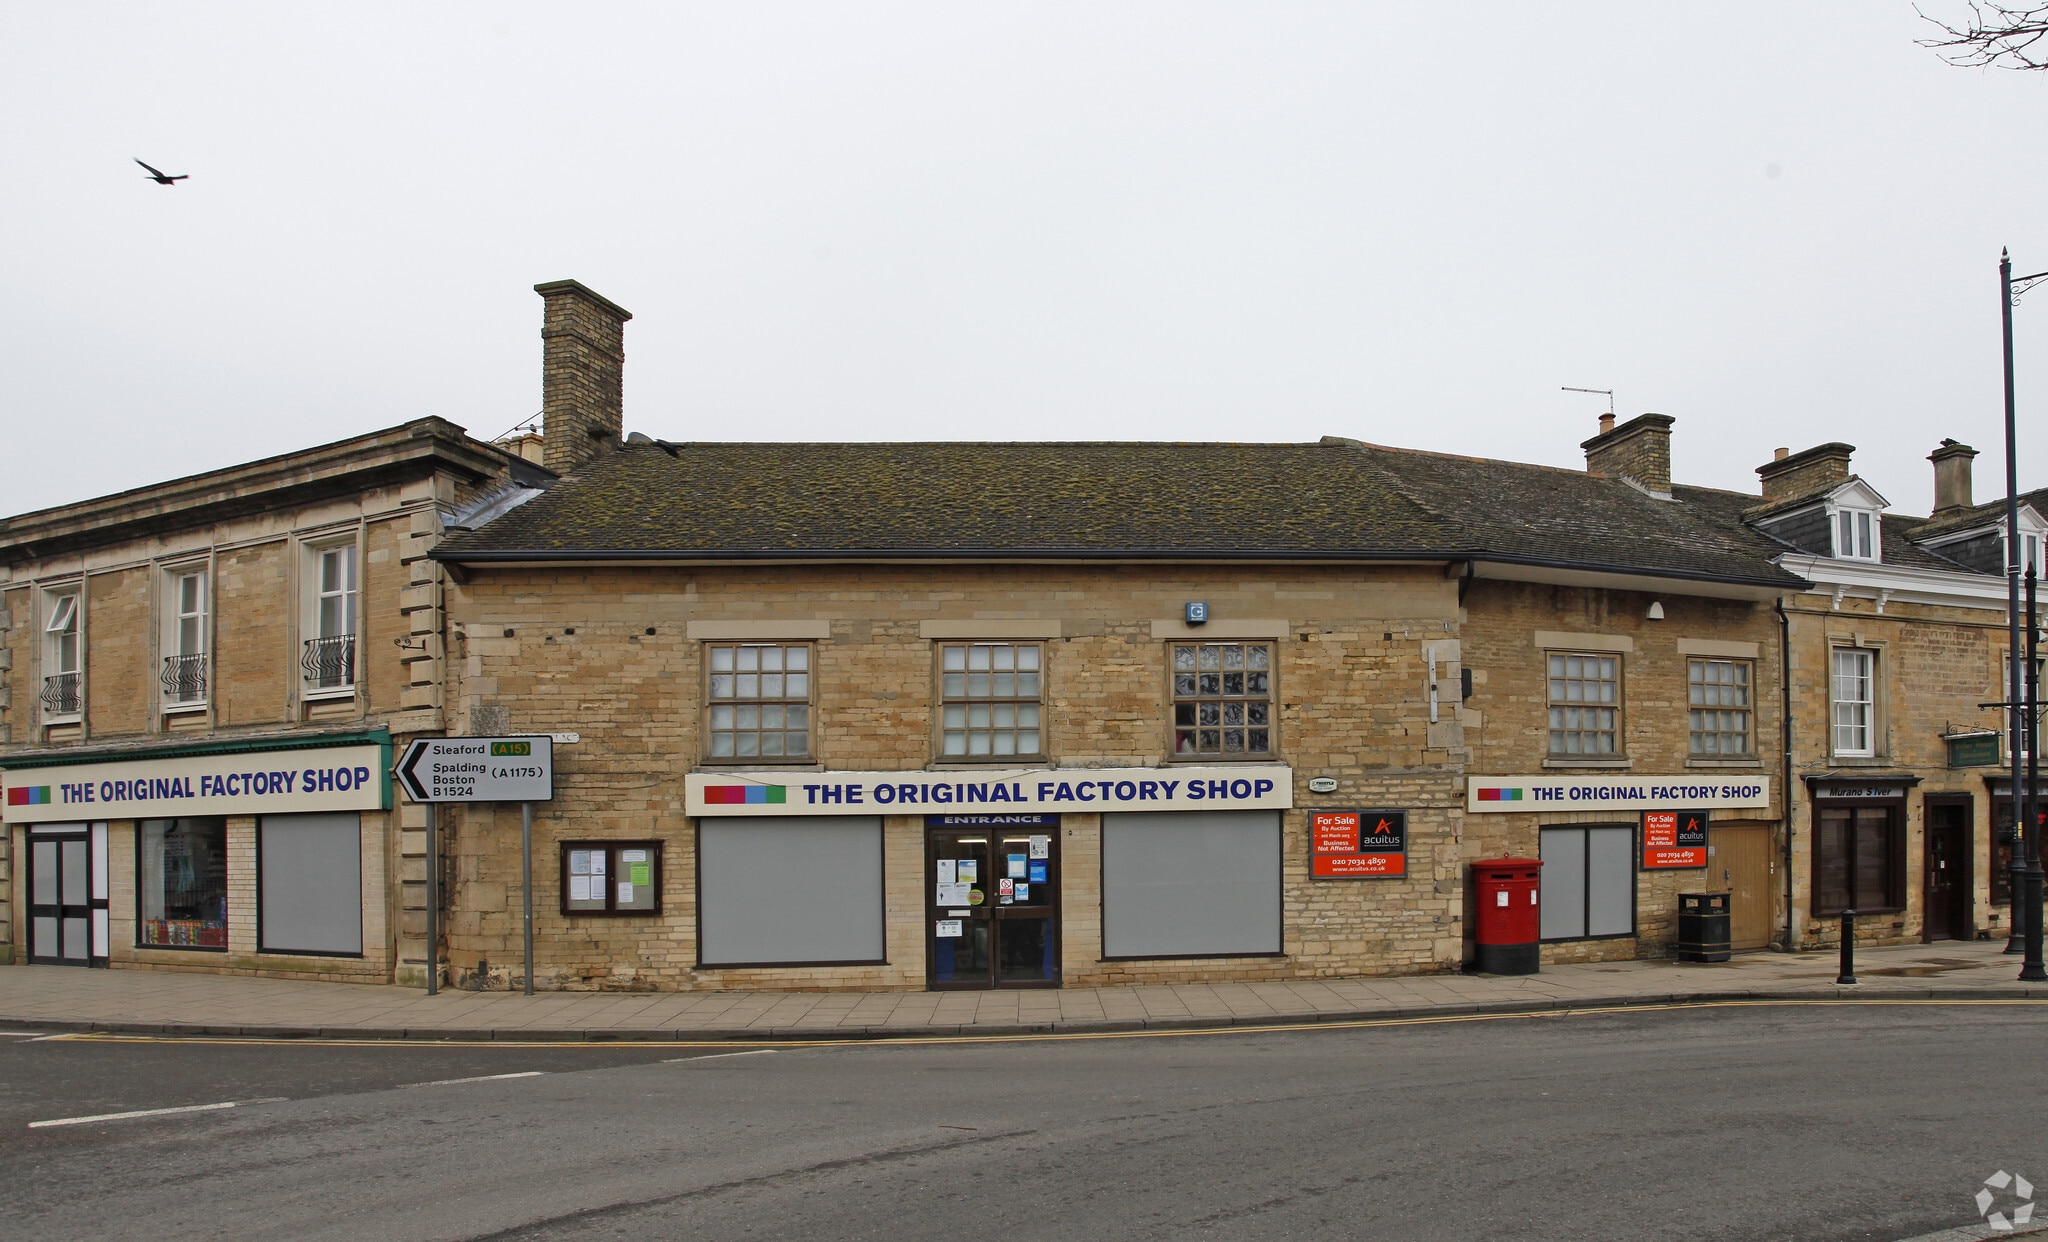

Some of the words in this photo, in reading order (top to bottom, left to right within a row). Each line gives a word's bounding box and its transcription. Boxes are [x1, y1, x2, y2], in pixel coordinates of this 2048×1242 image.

[433, 745, 485, 755] Sleaford
[433, 763, 486, 773] Spalding
[492, 766, 543, 778] (A1175)
[61, 783, 95, 804] THE
[100, 776, 195, 802] ORIGINAL
[201, 771, 297, 797] FACTORY
[302, 766, 370, 793] SHOP
[433, 775, 475, 785] Boston
[433, 786, 473, 796] B1524
[803, 784, 863, 804] THE
[873, 783, 1028, 804] ORIGINAL
[1037, 780, 1180, 802] FACTORY
[1186, 779, 1274, 800] SHOP
[1532, 787, 1564, 800] THE
[1569, 786, 1647, 800] ORIGINAL
[1651, 785, 1718, 799] FACTORY
[1721, 785, 1761, 799] SHOP
[1829, 788, 1863, 796] Murano
[944, 816, 1042, 824] ENTRANCE
[1317, 817, 1332, 825] For
[1334, 817, 1355, 825] Sale
[1659, 815, 1674, 823] Sale
[1364, 835, 1400, 844] acuitus
[1679, 832, 1704, 840] acuitus
[1348, 859, 1366, 867] 7034
[1367, 857, 1387, 866] 4850
